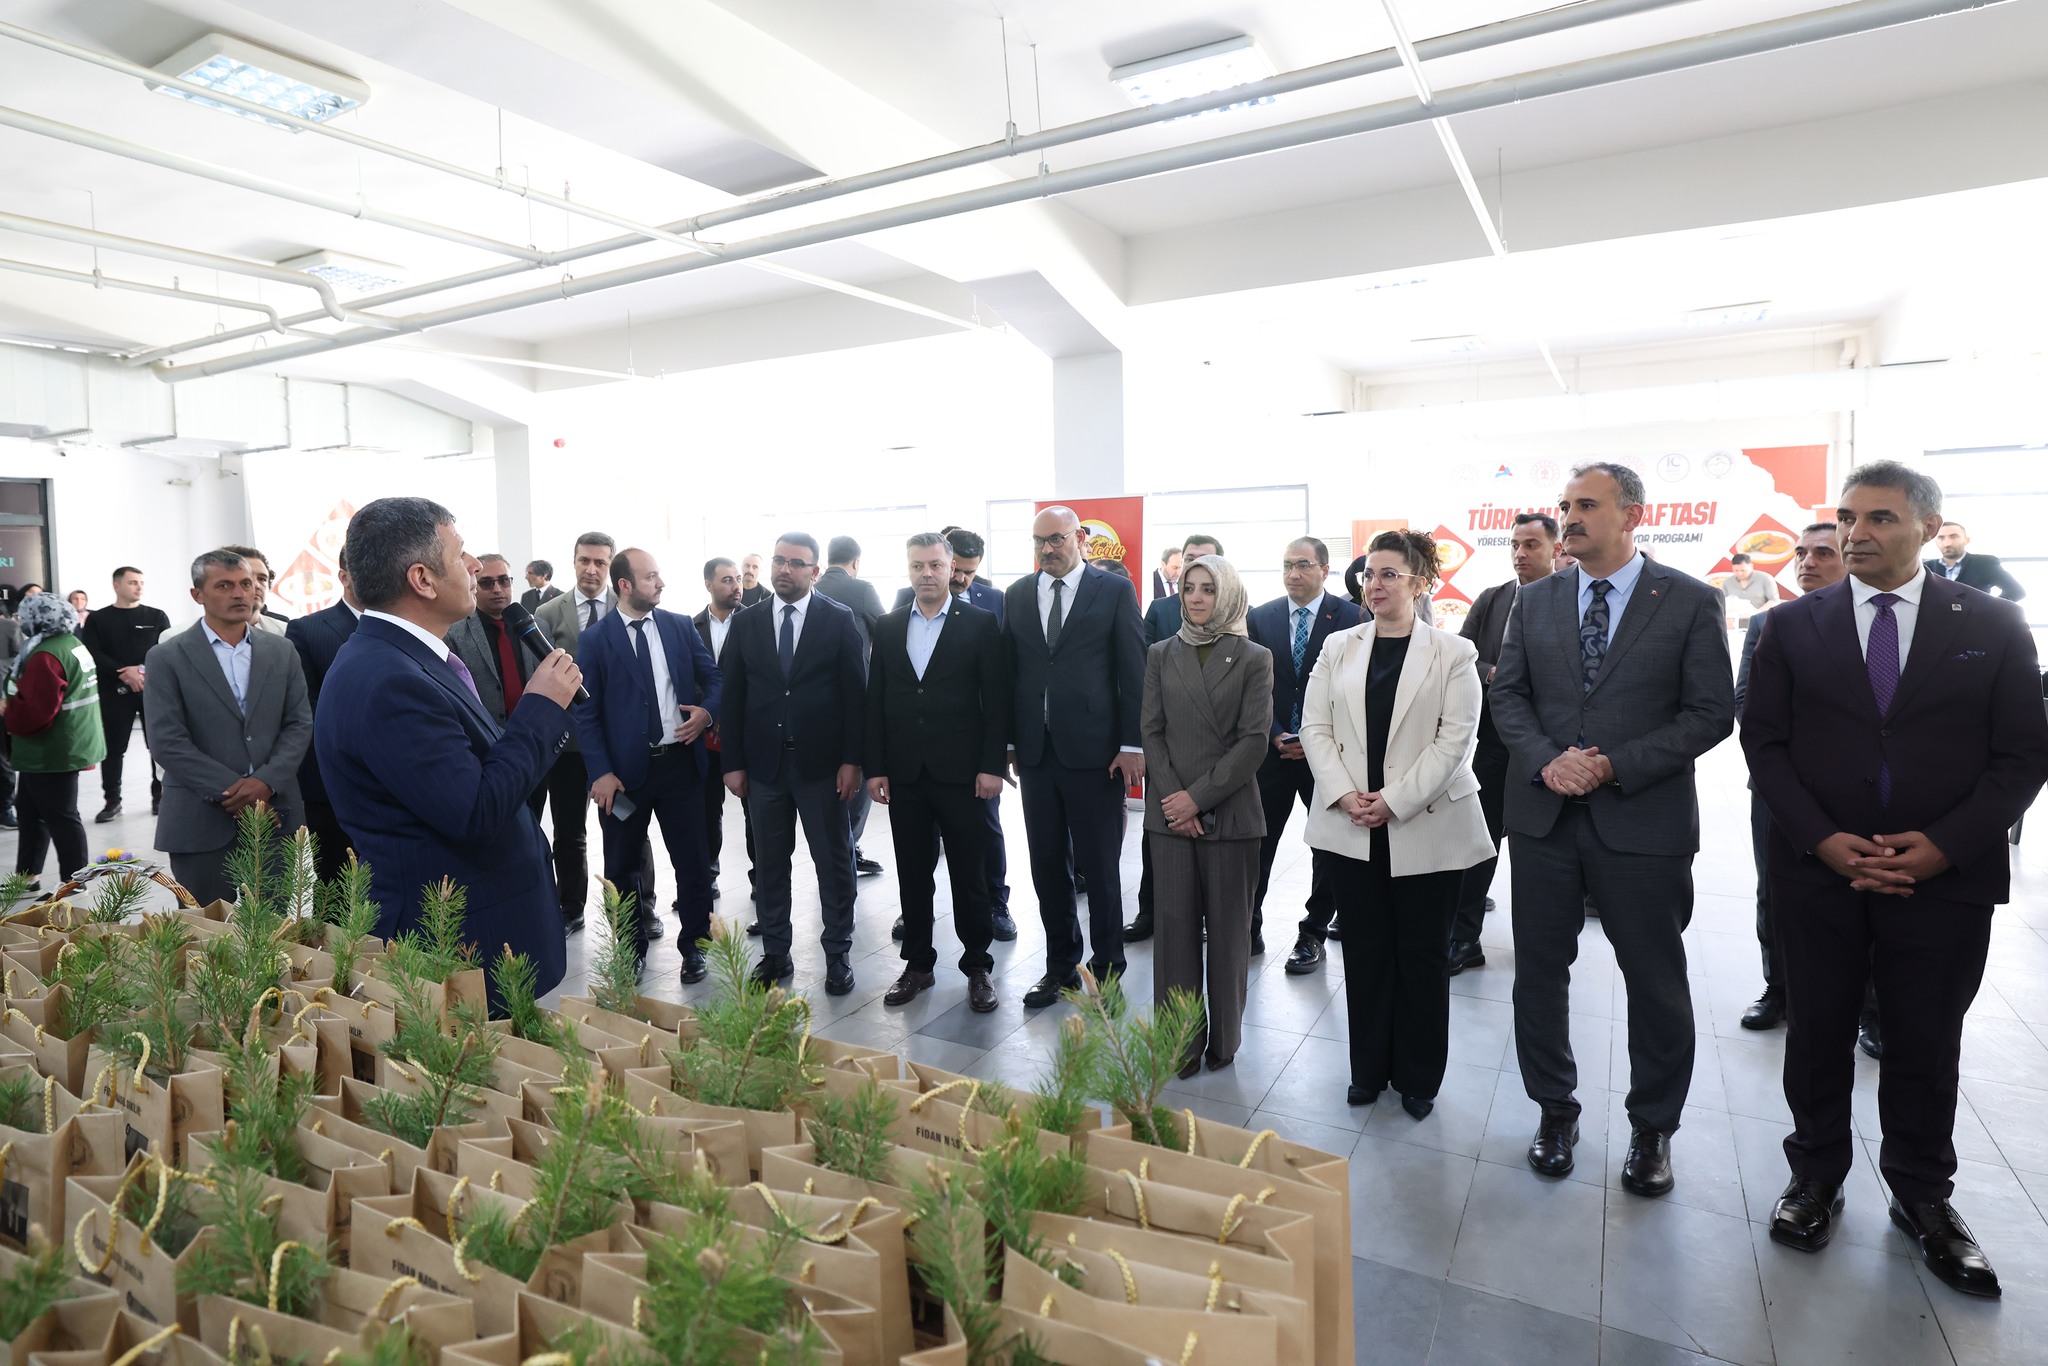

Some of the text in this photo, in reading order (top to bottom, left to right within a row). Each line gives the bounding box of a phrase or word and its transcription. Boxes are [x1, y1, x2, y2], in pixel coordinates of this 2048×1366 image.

[1637, 501, 1718, 527] AFTASI
[1652, 532, 1704, 544] PROGRAMI
[916, 1126, 942, 1143] FİDAN
